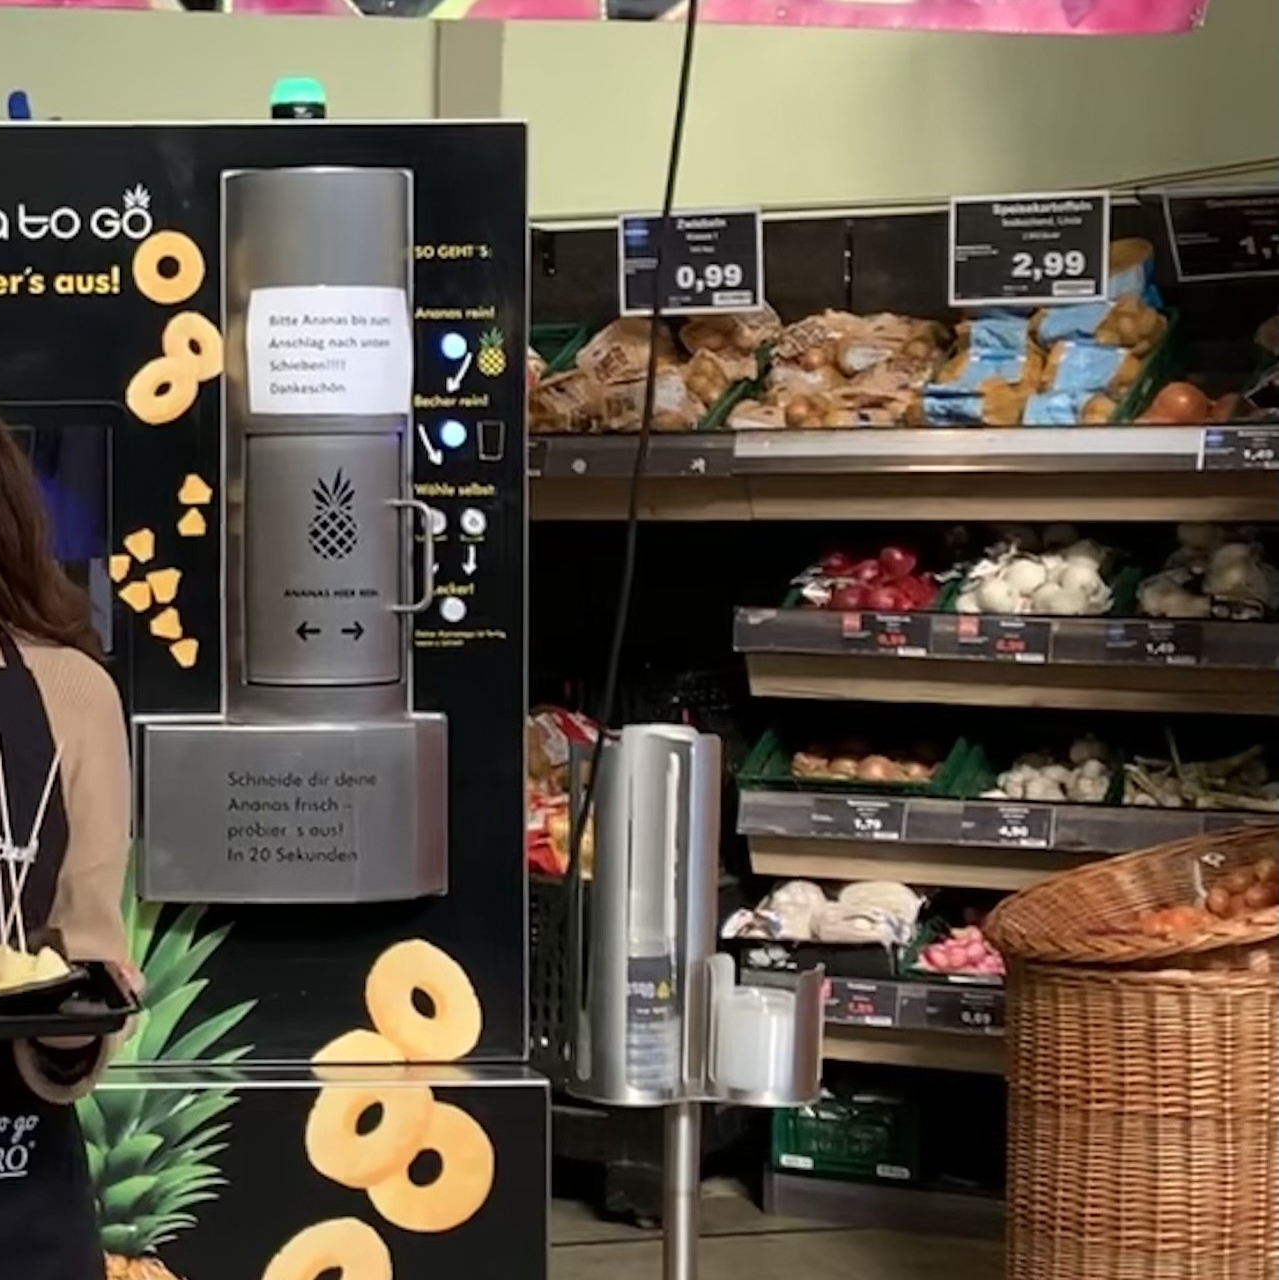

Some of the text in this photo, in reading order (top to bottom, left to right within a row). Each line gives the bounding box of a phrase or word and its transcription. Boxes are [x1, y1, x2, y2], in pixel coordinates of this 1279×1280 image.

[19, 204, 81, 239] to
[1011, 252, 1086, 282] 2,99
[54, 265, 121, 295] aus!
[677, 264, 742, 293] 0,99
[303, 314, 349, 326] Ananas
[351, 314, 367, 326] bis
[269, 337, 325, 351] Anschlag
[329, 338, 357, 348] nach
[270, 382, 346, 394] Dankeschön
[228, 771, 303, 787] Schneide
[335, 771, 377, 787] deine
[228, 798, 290, 812] Ananas
[295, 797, 339, 812] frisch
[249, 847, 271, 862] 20
[276, 847, 358, 863] Sekunden
